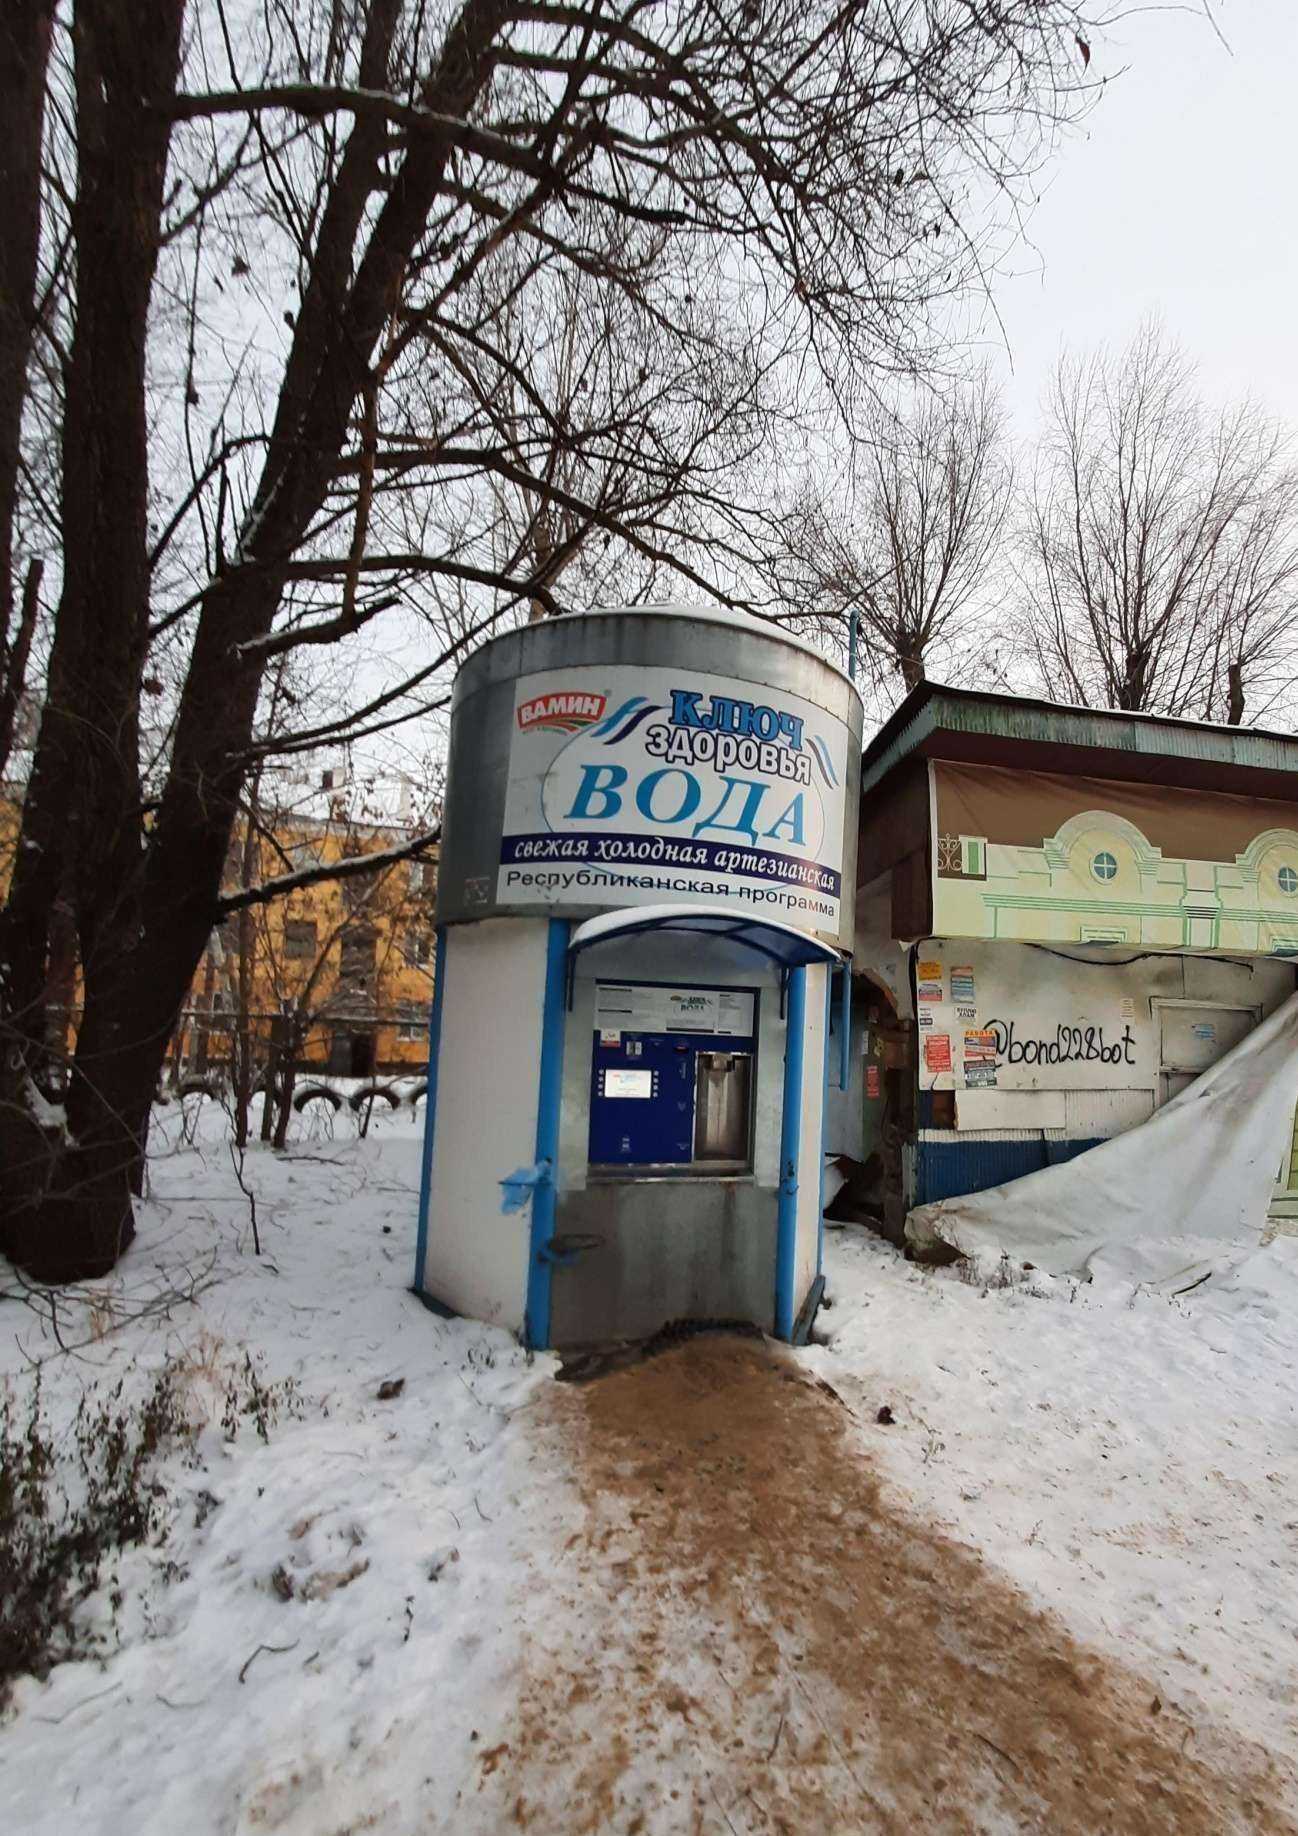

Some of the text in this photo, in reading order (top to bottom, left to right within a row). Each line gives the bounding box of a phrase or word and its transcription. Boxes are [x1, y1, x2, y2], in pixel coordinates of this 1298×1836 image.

[521, 696, 601, 724] ВАМИН
[669, 690, 804, 750] КЛЮЧ
[563, 764, 806, 846] ВОДА
[514, 837, 835, 891] свежая холодная артезианская
[506, 869, 834, 917] Республиканская программа
